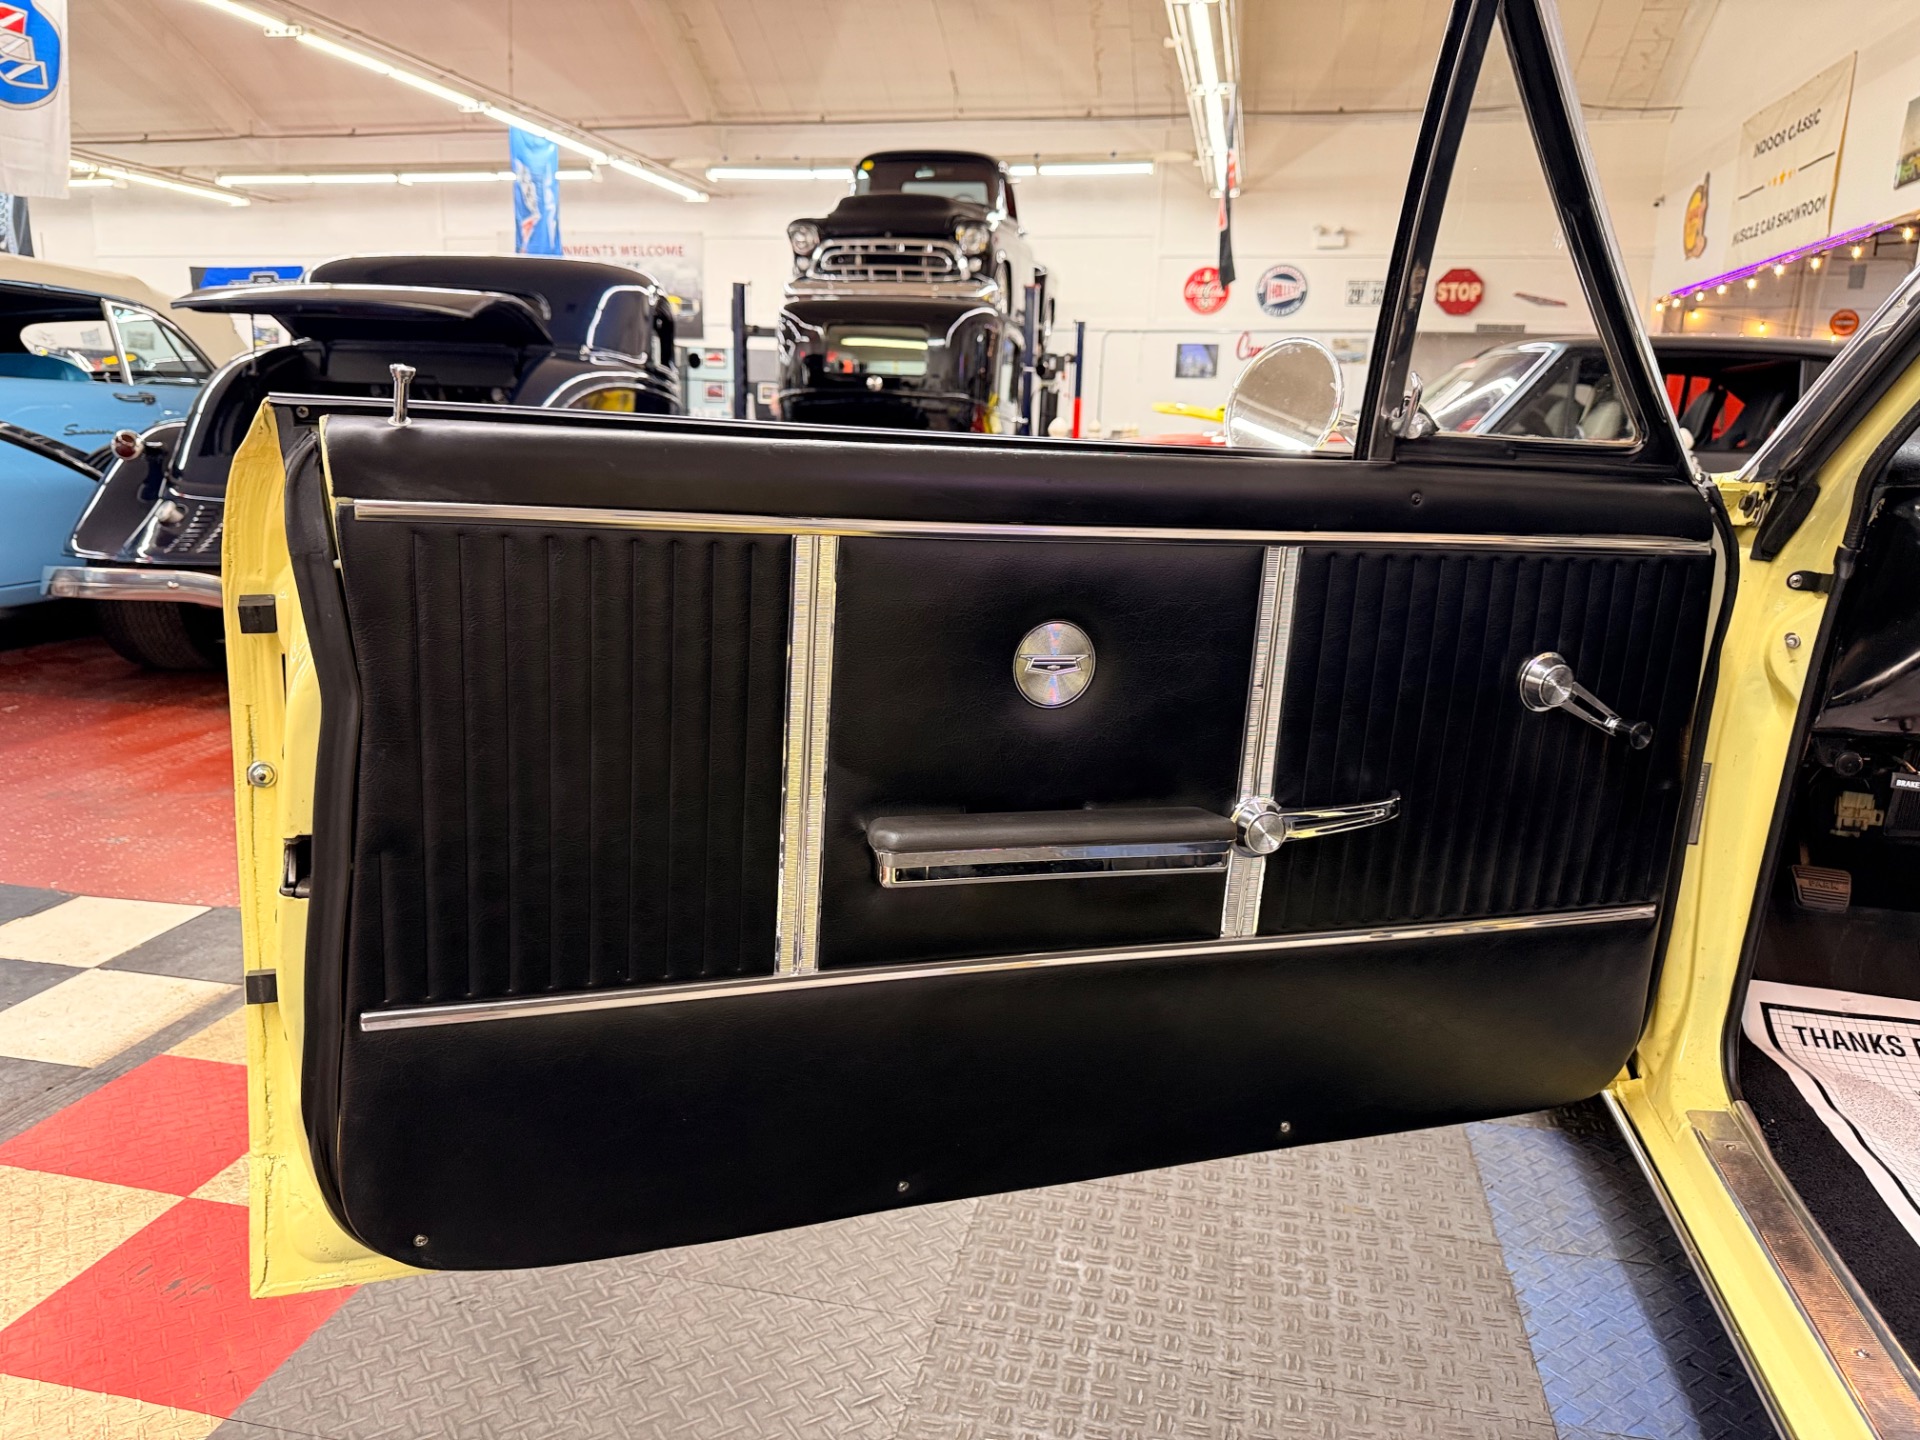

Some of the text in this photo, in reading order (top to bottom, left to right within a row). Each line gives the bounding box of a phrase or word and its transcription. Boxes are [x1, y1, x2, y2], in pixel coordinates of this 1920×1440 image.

[1787, 108, 1822, 142] CLASSIC
[620, 243, 685, 257] WELCOME
[1437, 281, 1482, 302] STOP
[1896, 779, 1920, 789] BRAKE
[1808, 880, 1840, 891] PARK
[1792, 1025, 1906, 1058] THANKS
